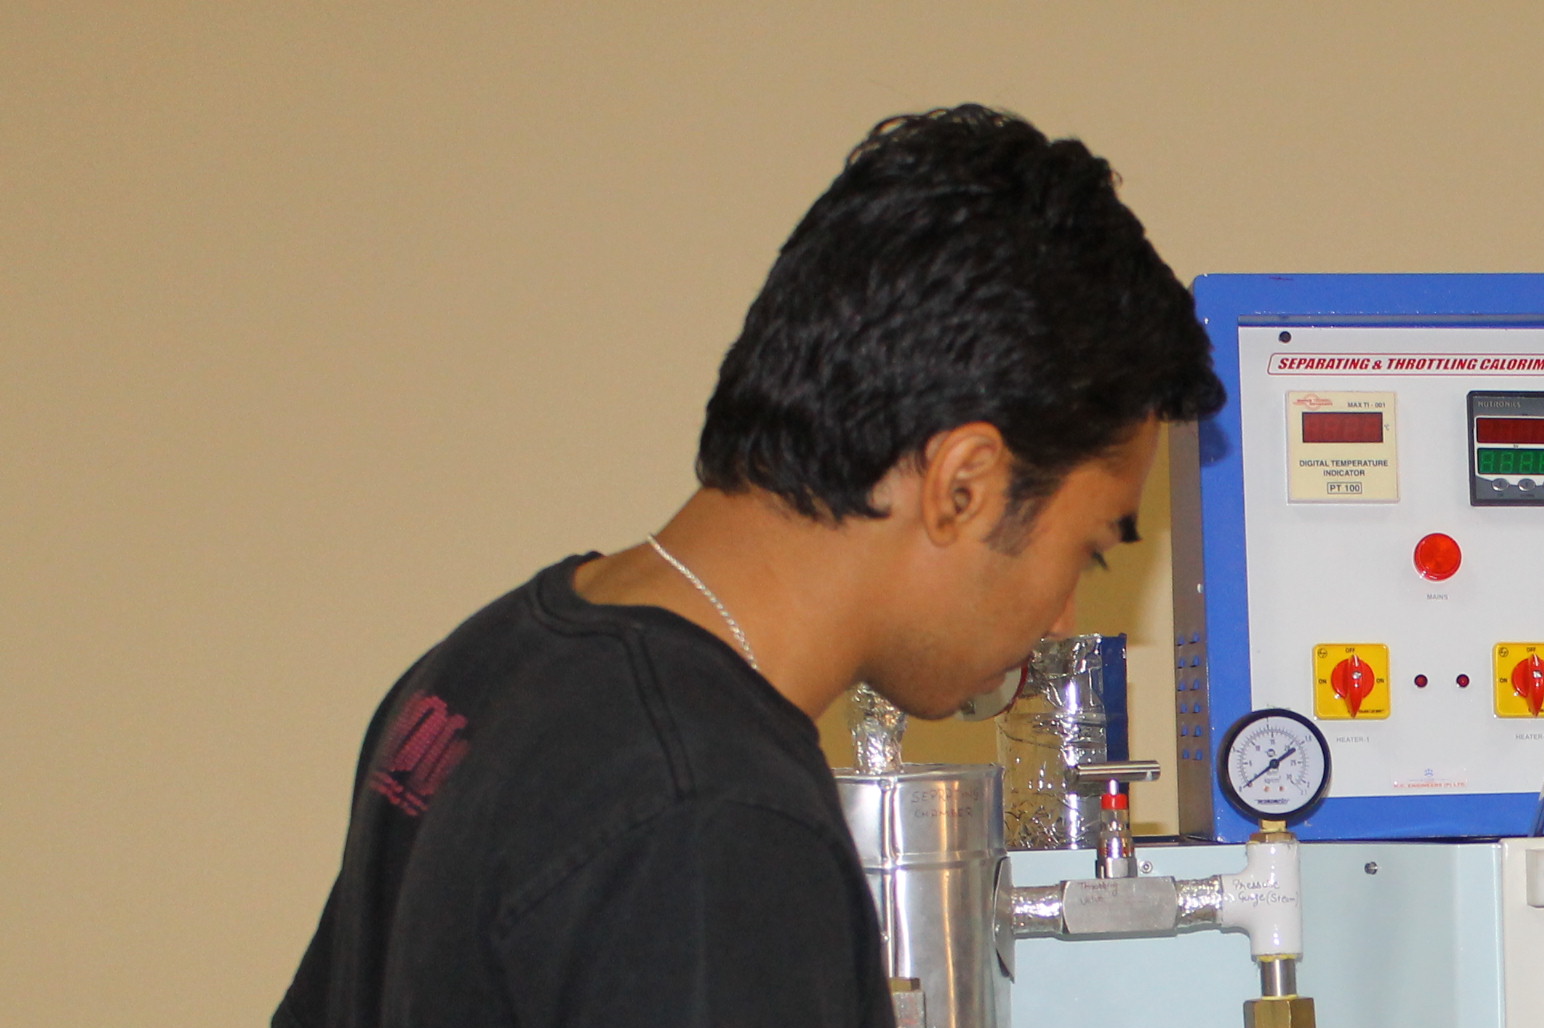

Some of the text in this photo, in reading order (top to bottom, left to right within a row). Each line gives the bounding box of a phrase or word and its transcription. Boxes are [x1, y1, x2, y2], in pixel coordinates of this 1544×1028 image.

[1278, 358, 1371, 370] SEPARATING
[1372, 360, 1382, 370] &
[1387, 358, 1478, 370] THROTTLING
